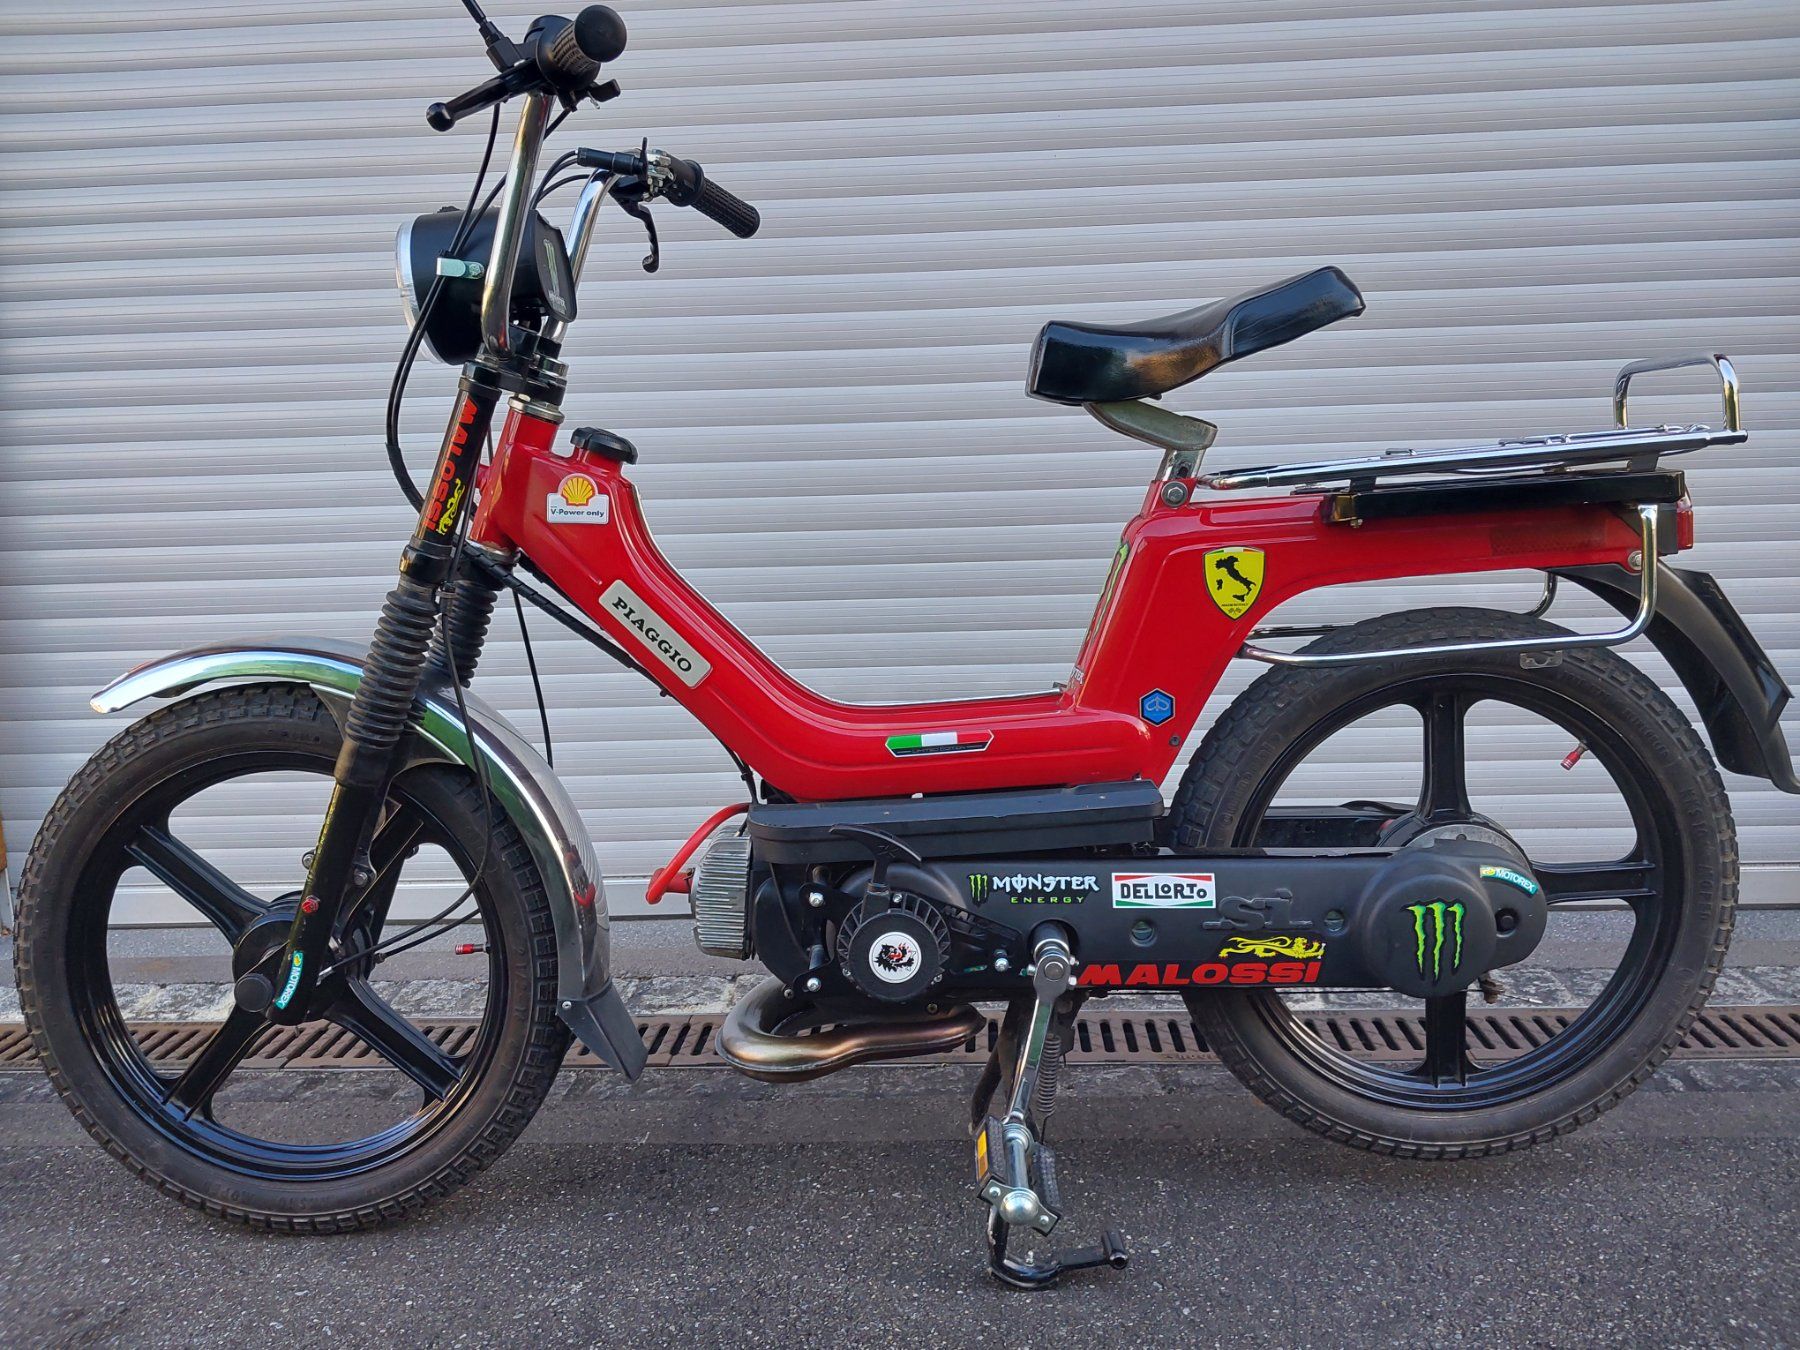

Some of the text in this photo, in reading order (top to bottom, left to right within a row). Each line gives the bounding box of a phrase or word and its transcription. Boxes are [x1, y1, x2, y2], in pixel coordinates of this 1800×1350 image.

[422, 397, 478, 531] MALOSSI
[550, 508, 605, 518] V-Power only
[612, 596, 692, 672] PIAGGIO
[992, 873, 1100, 893] MONSTER
[1495, 868, 1535, 892] MOTOREX
[1010, 896, 1085, 904] ENERGY
[1076, 961, 1322, 986] MALOSSI
[277, 966, 302, 1006] MOTOREX
